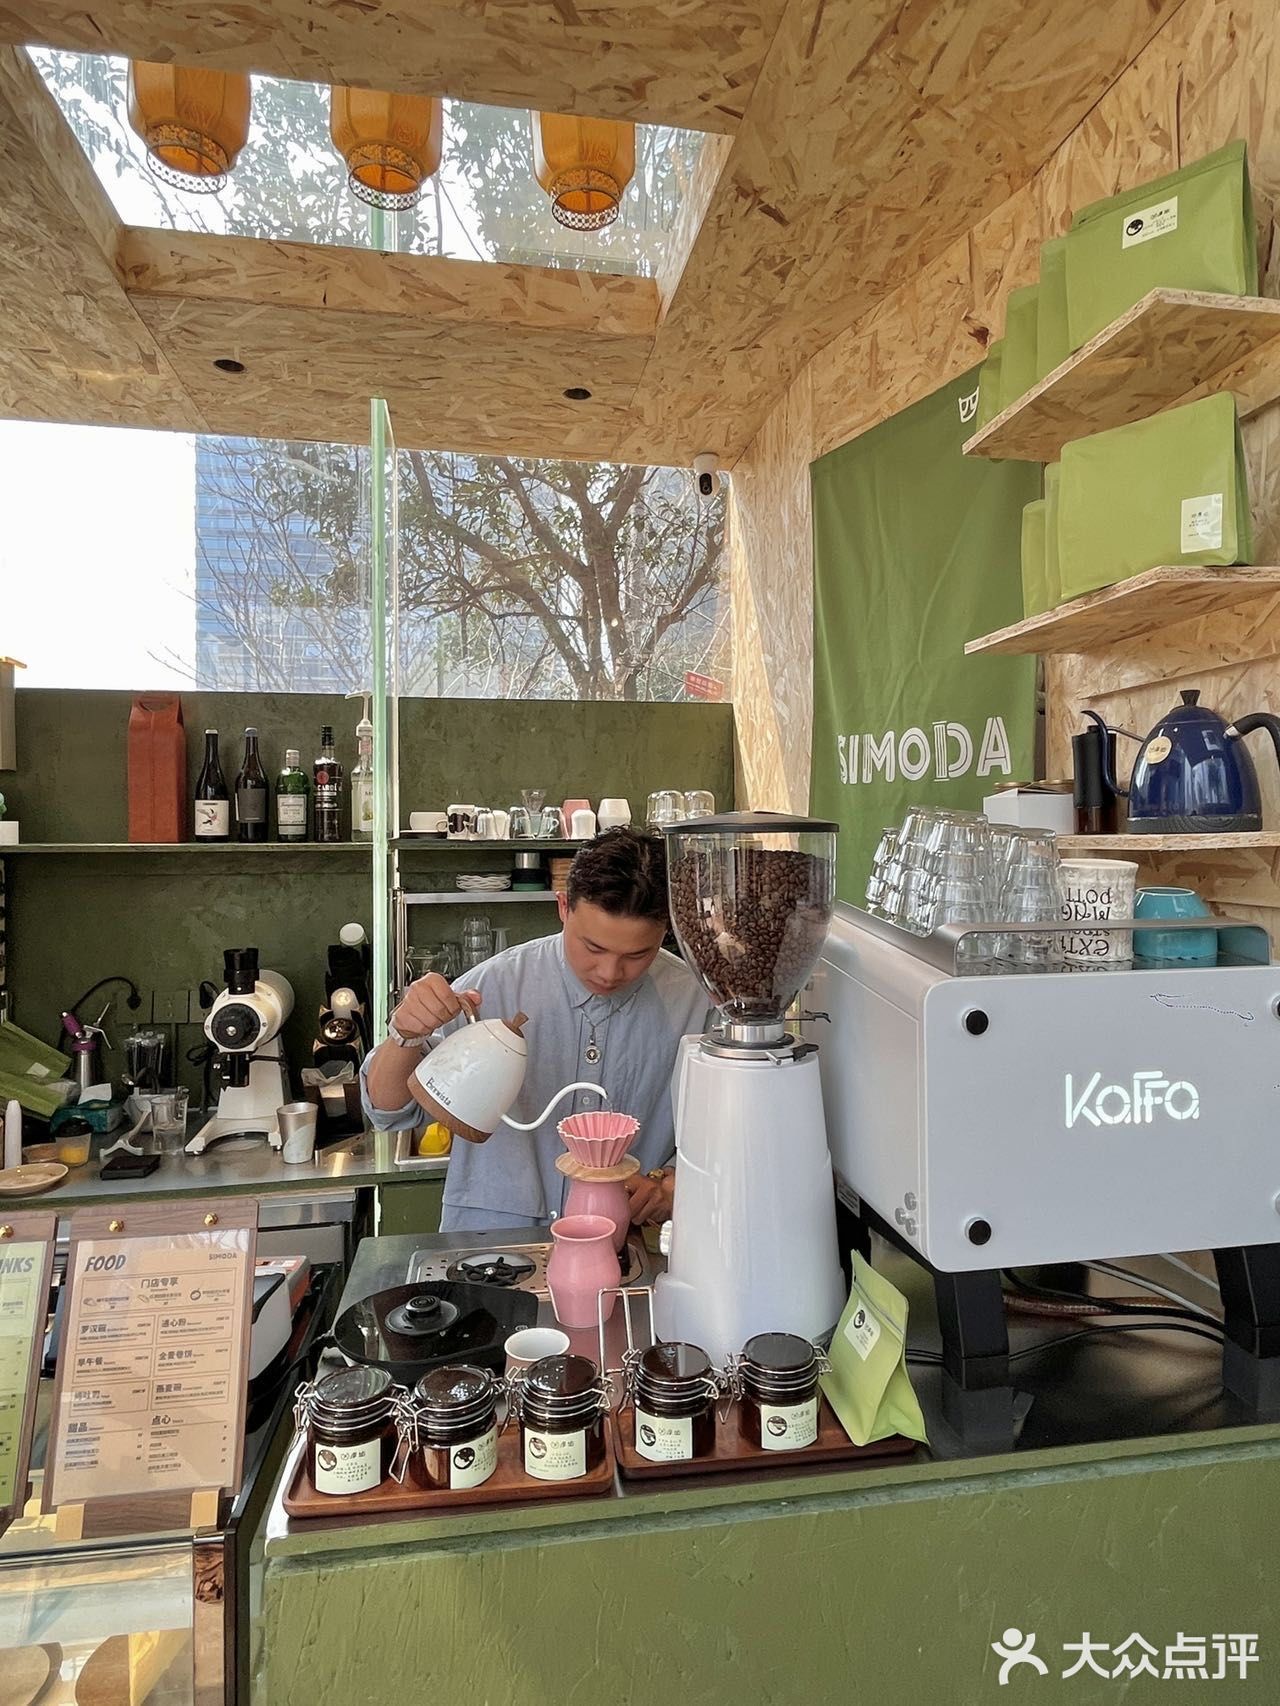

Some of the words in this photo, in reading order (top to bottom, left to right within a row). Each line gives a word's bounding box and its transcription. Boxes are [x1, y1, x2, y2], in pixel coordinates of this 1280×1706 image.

[837, 716, 1012, 785] SIMODA
[84, 1254, 127, 1273] FOOD
[208, 1252, 238, 1261] SIMODA
[141, 1277, 179, 1289] 门店专享
